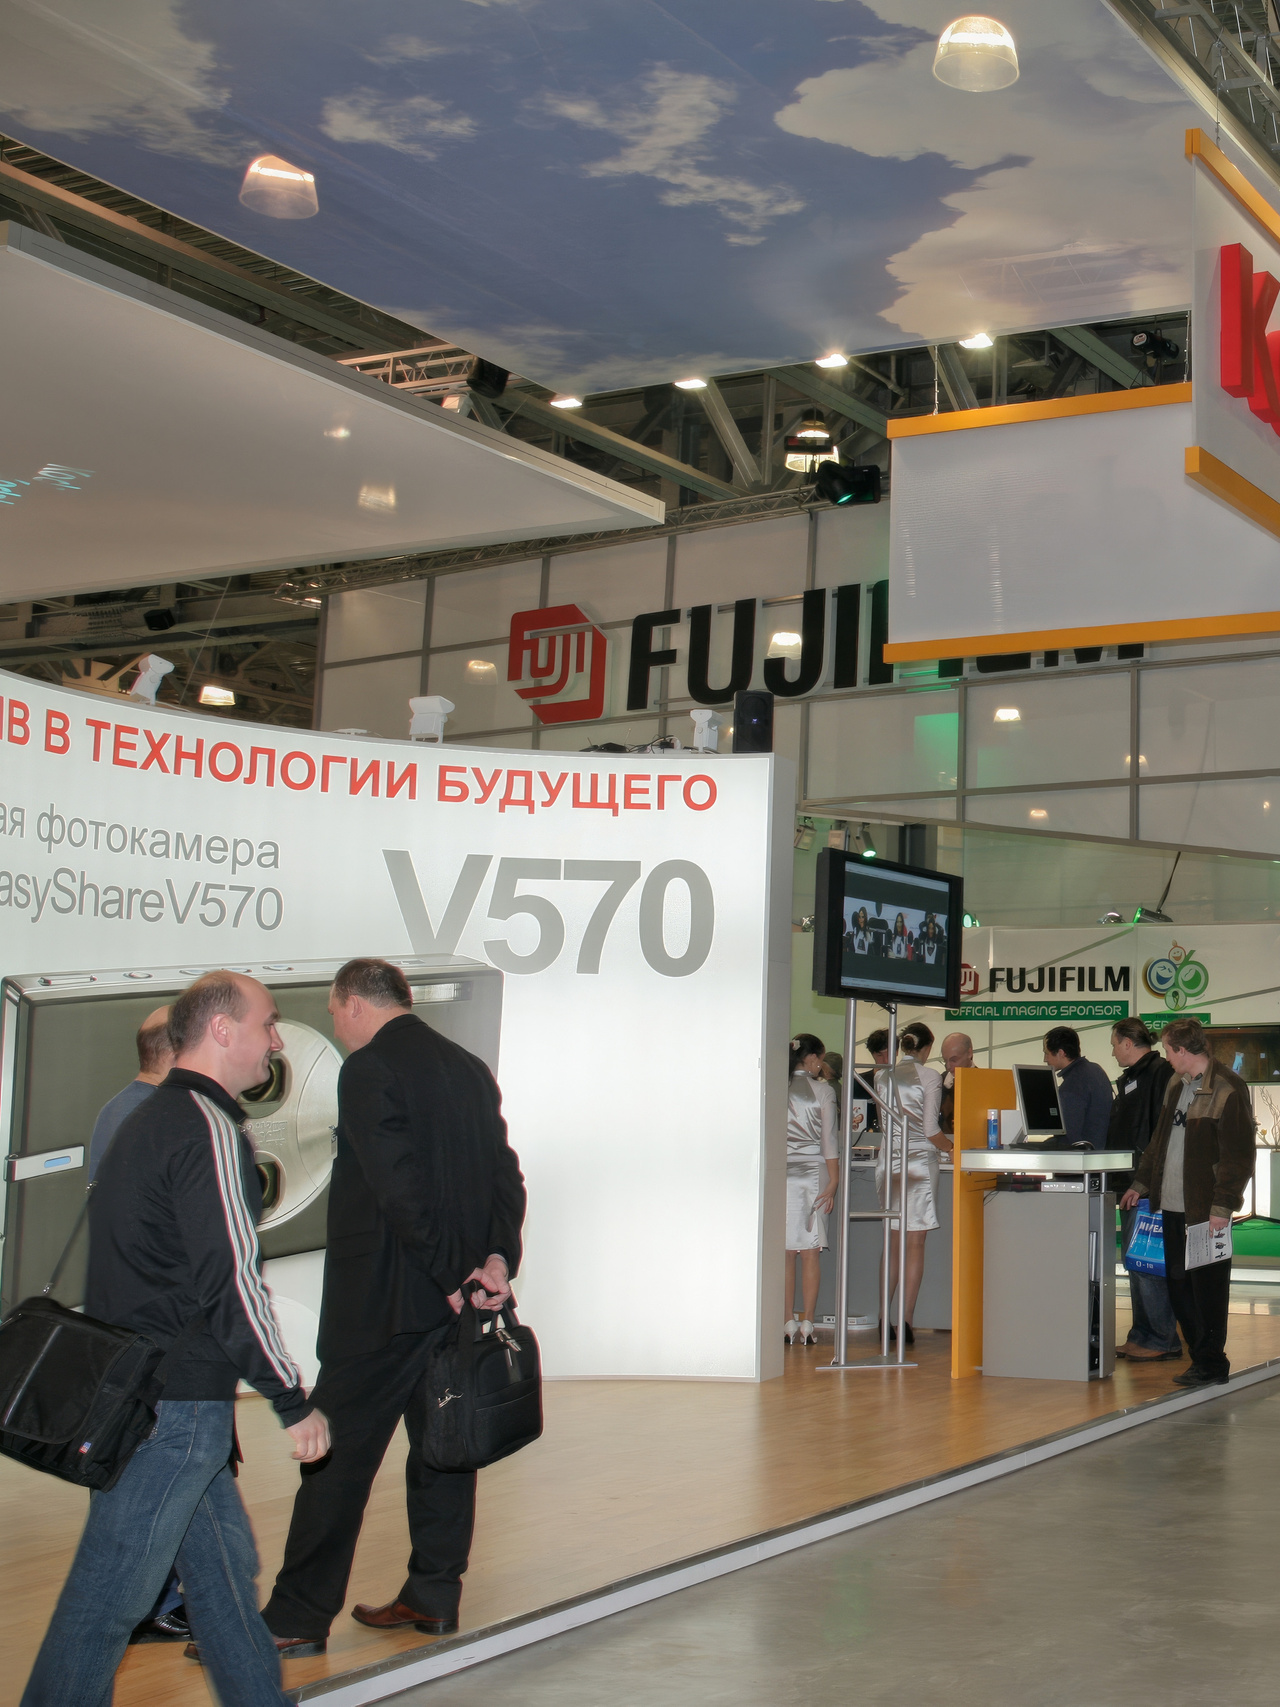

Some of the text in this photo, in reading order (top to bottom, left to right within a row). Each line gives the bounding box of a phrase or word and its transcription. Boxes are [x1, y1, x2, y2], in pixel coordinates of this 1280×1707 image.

[45, 708, 71, 755] В
[85, 717, 418, 800] ТЕХНОЛОГИИ
[436, 764, 718, 818] БУДУЩЕГО
[36, 803, 280, 875] фотокамера
[381, 848, 716, 978] V570
[989, 966, 1131, 992] FUJIFILM
[1002, 1005, 1058, 1016] IMAGING
[1060, 1004, 1122, 1016] SPONSOR
[1139, 1221, 1163, 1233] NIVEA
